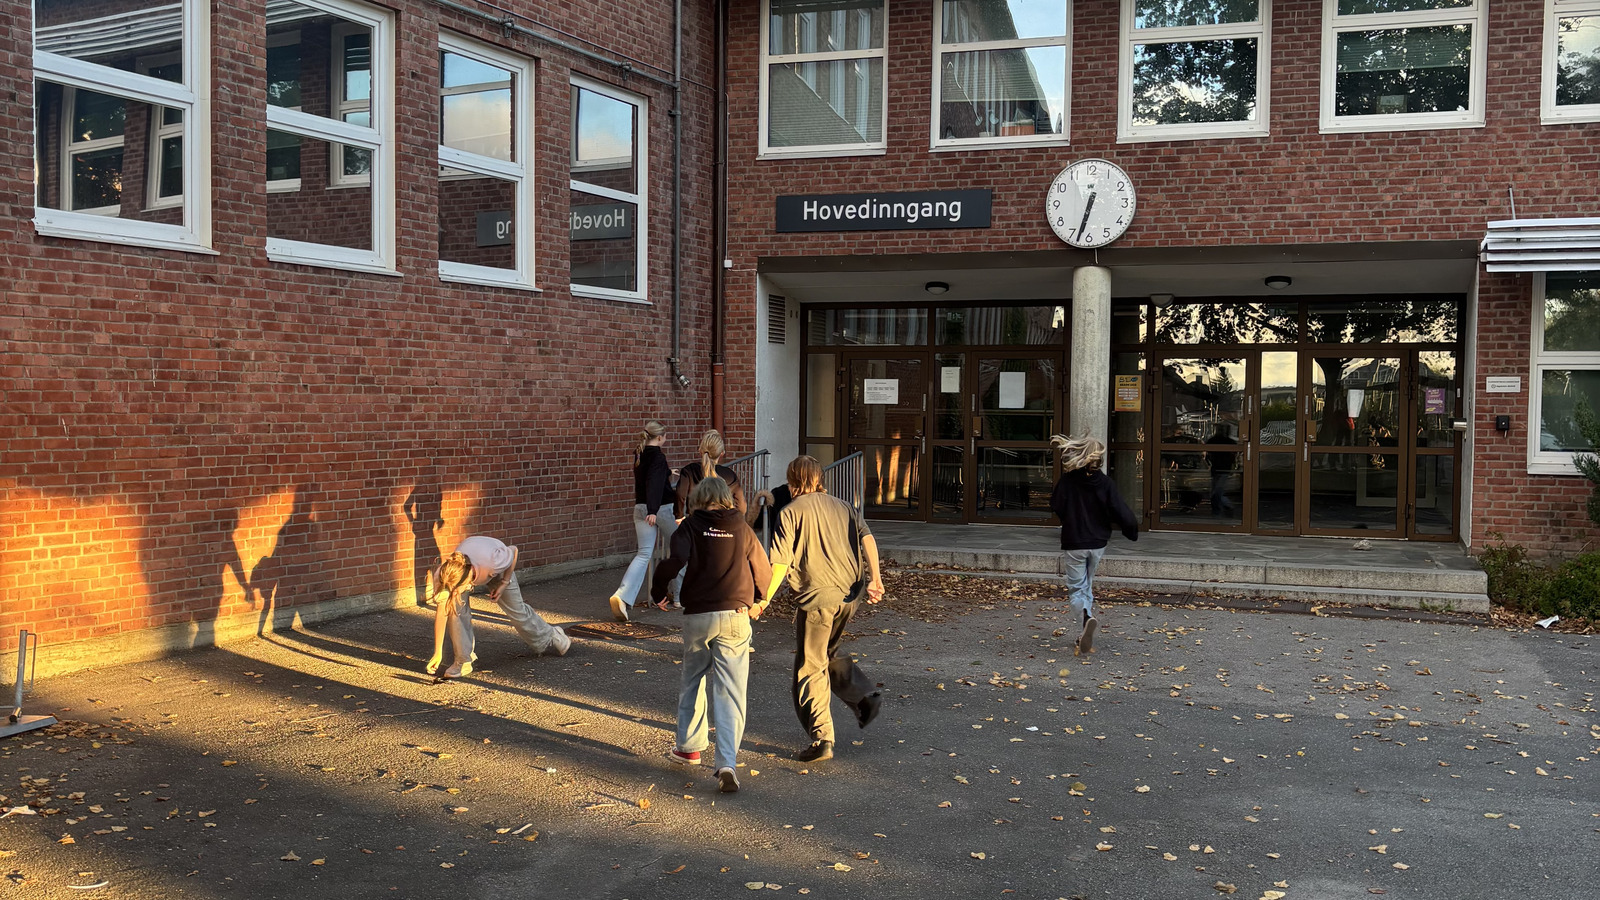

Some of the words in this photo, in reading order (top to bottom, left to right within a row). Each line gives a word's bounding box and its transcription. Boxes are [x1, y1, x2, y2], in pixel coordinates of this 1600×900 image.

[1087, 165, 1097, 175] 12
[1057, 182, 1067, 193] 10
[1117, 181, 1125, 191] 2
[1053, 200, 1061, 210] 9
[1121, 198, 1129, 209] 3
[803, 199, 962, 223] Hovedinngang
[1057, 216, 1065, 227] 8
[1116, 215, 1124, 225] 4
[1069, 228, 1077, 239] 7
[1085, 233, 1093, 242] 6
[1102, 228, 1111, 238] 5
